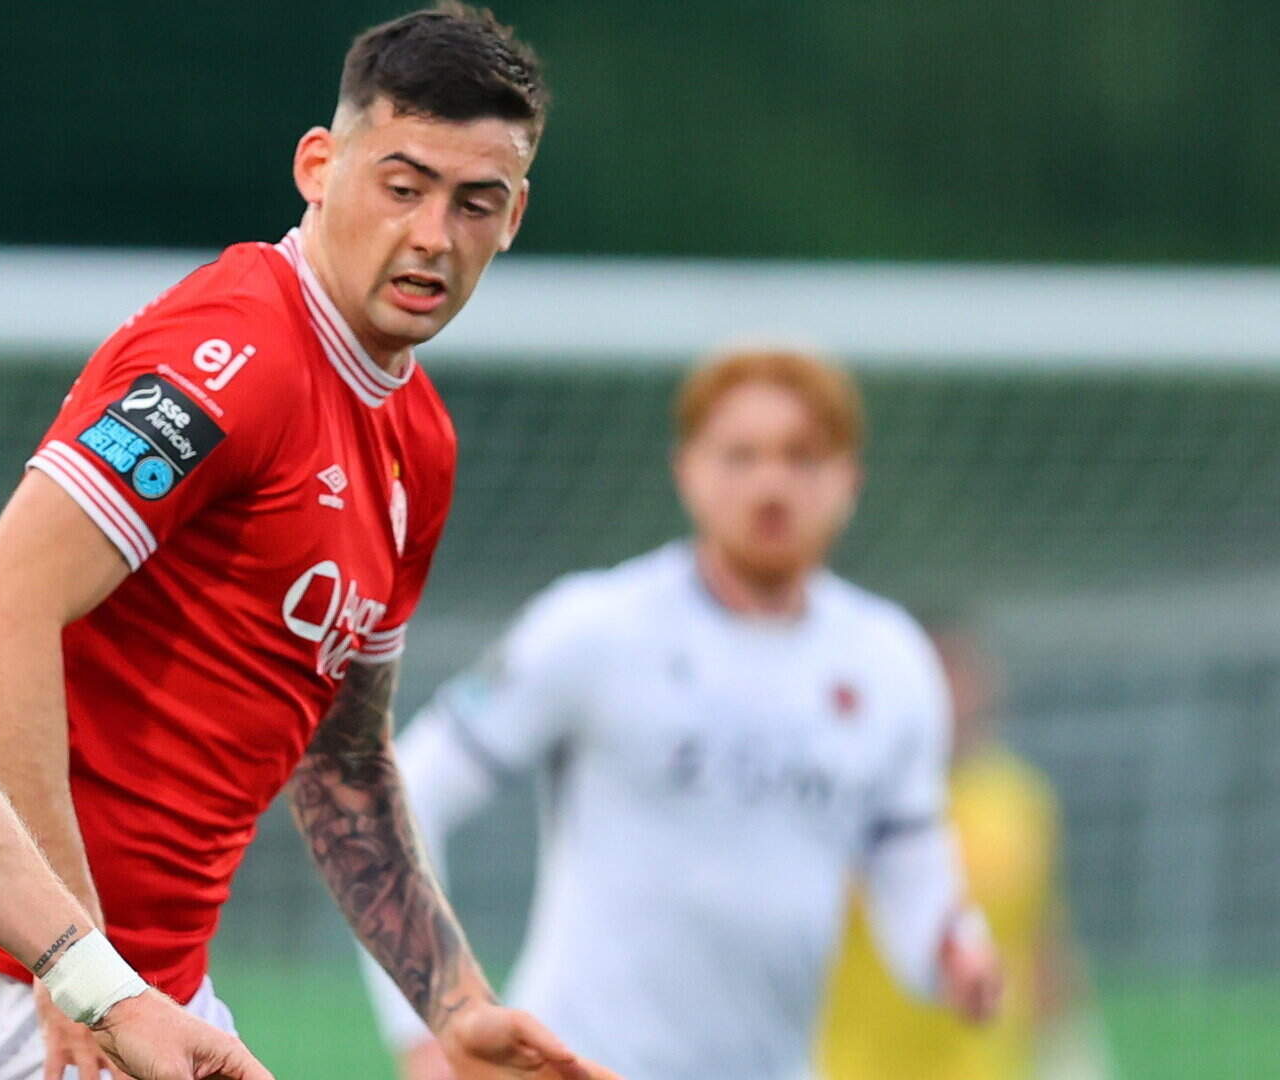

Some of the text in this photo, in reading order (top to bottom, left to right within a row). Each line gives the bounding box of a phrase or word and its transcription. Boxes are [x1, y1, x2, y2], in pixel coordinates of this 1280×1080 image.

[192, 338, 257, 391] ej
[144, 410, 197, 460] Airtricity
[156, 397, 191, 429] sse
